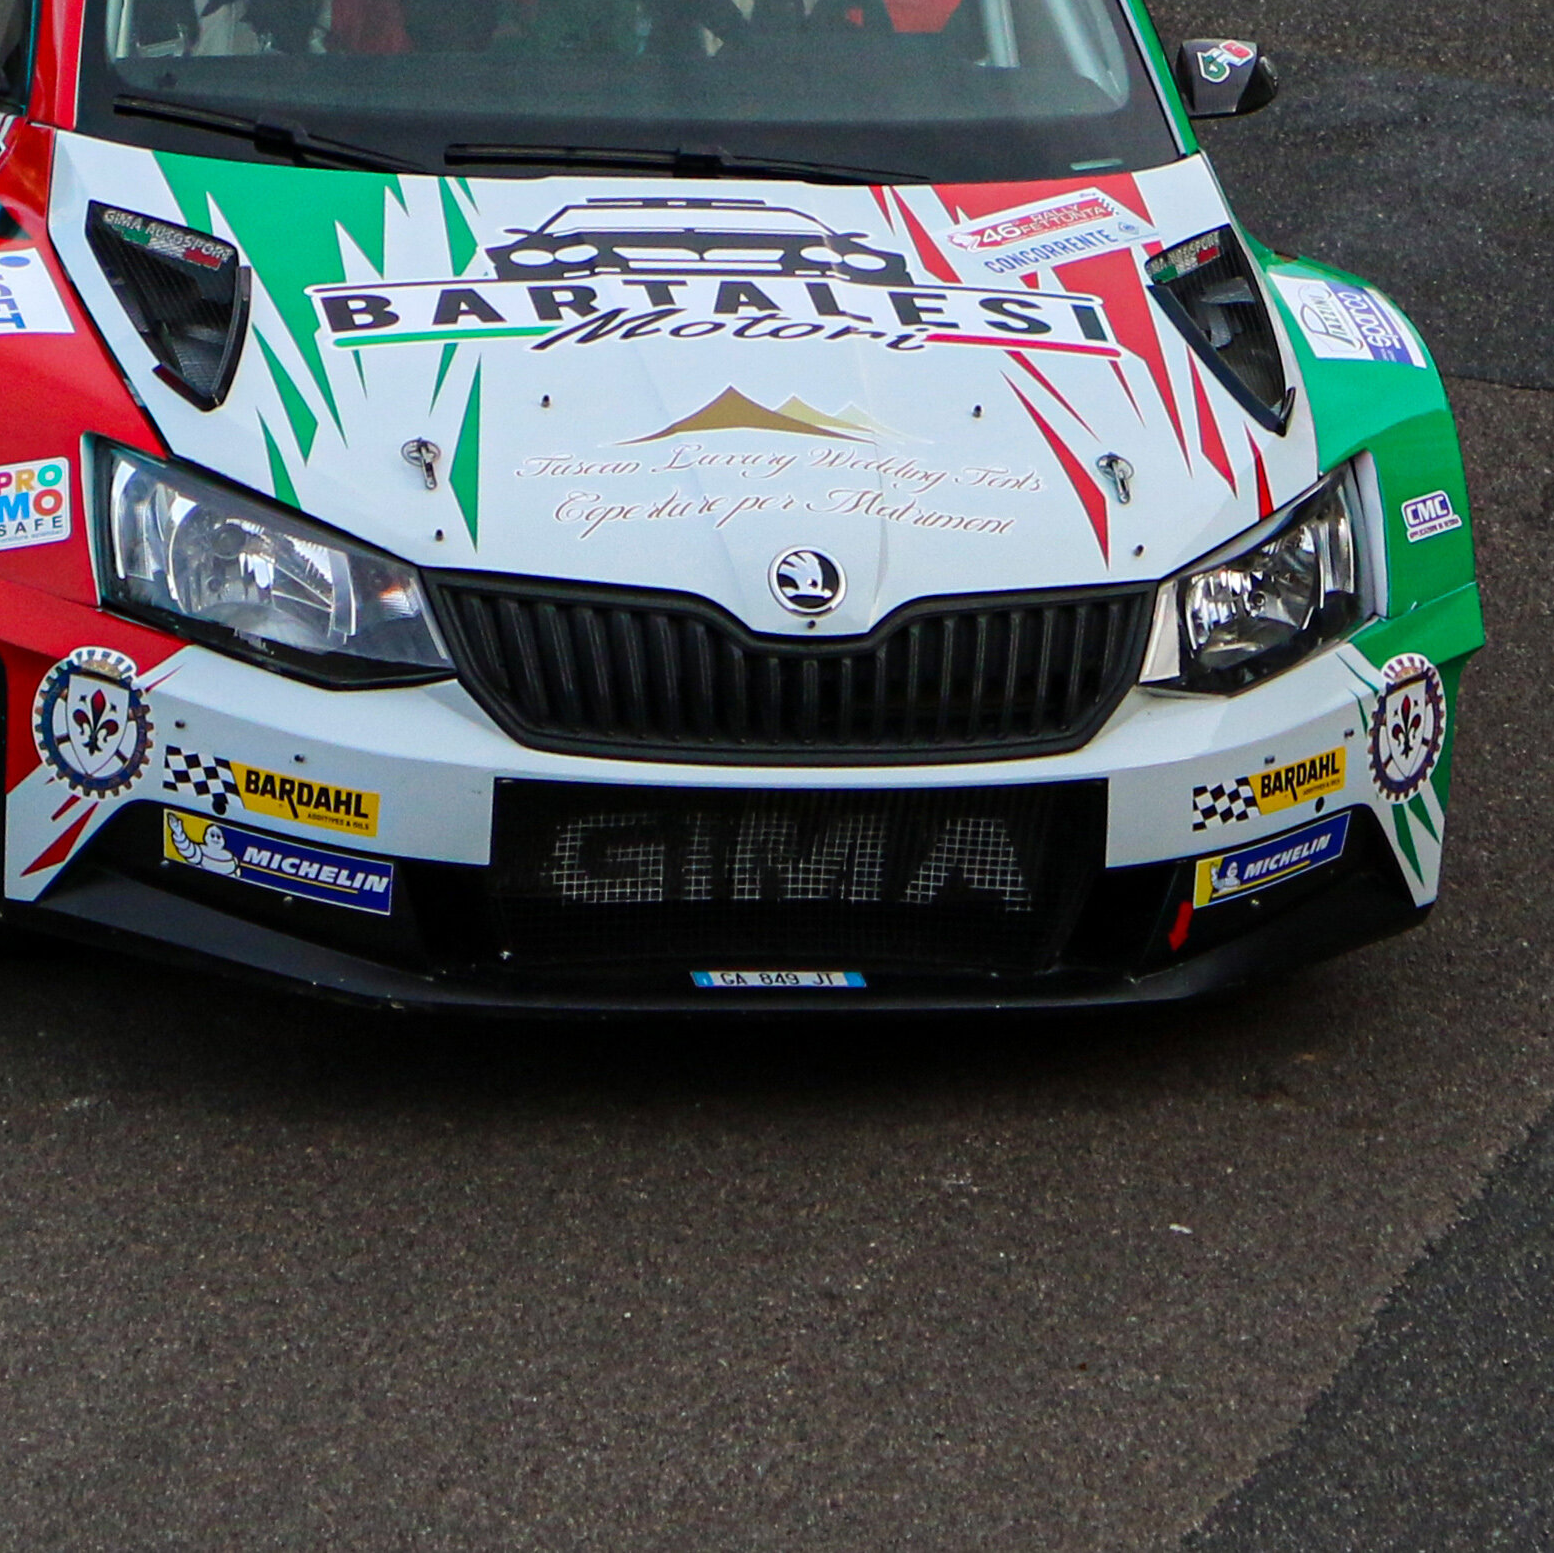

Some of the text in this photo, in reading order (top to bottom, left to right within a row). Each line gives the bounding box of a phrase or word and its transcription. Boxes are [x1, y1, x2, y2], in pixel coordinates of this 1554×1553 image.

[1020, 206, 1106, 235] FETTUNTA
[1030, 203, 1080, 224] RALLY
[983, 229, 1119, 274] CONCORRENTE
[320, 279, 1109, 342] BARTALESI
[529, 307, 930, 351] Motori
[1337, 291, 1398, 349] sparco
[514, 444, 1046, 494] Tuscan Luxury Wedding Tents
[554, 488, 1016, 540] Coperture per Matrimoni
[1406, 495, 1448, 525] CMC
[244, 769, 369, 819] BARDAHL
[1260, 751, 1340, 802] BARDAHL
[243, 846, 390, 893] MICHELIN
[552, 812, 1033, 912] GIMA
[1242, 833, 1332, 881] MICHELIN
[758, 972, 800, 985] 849
